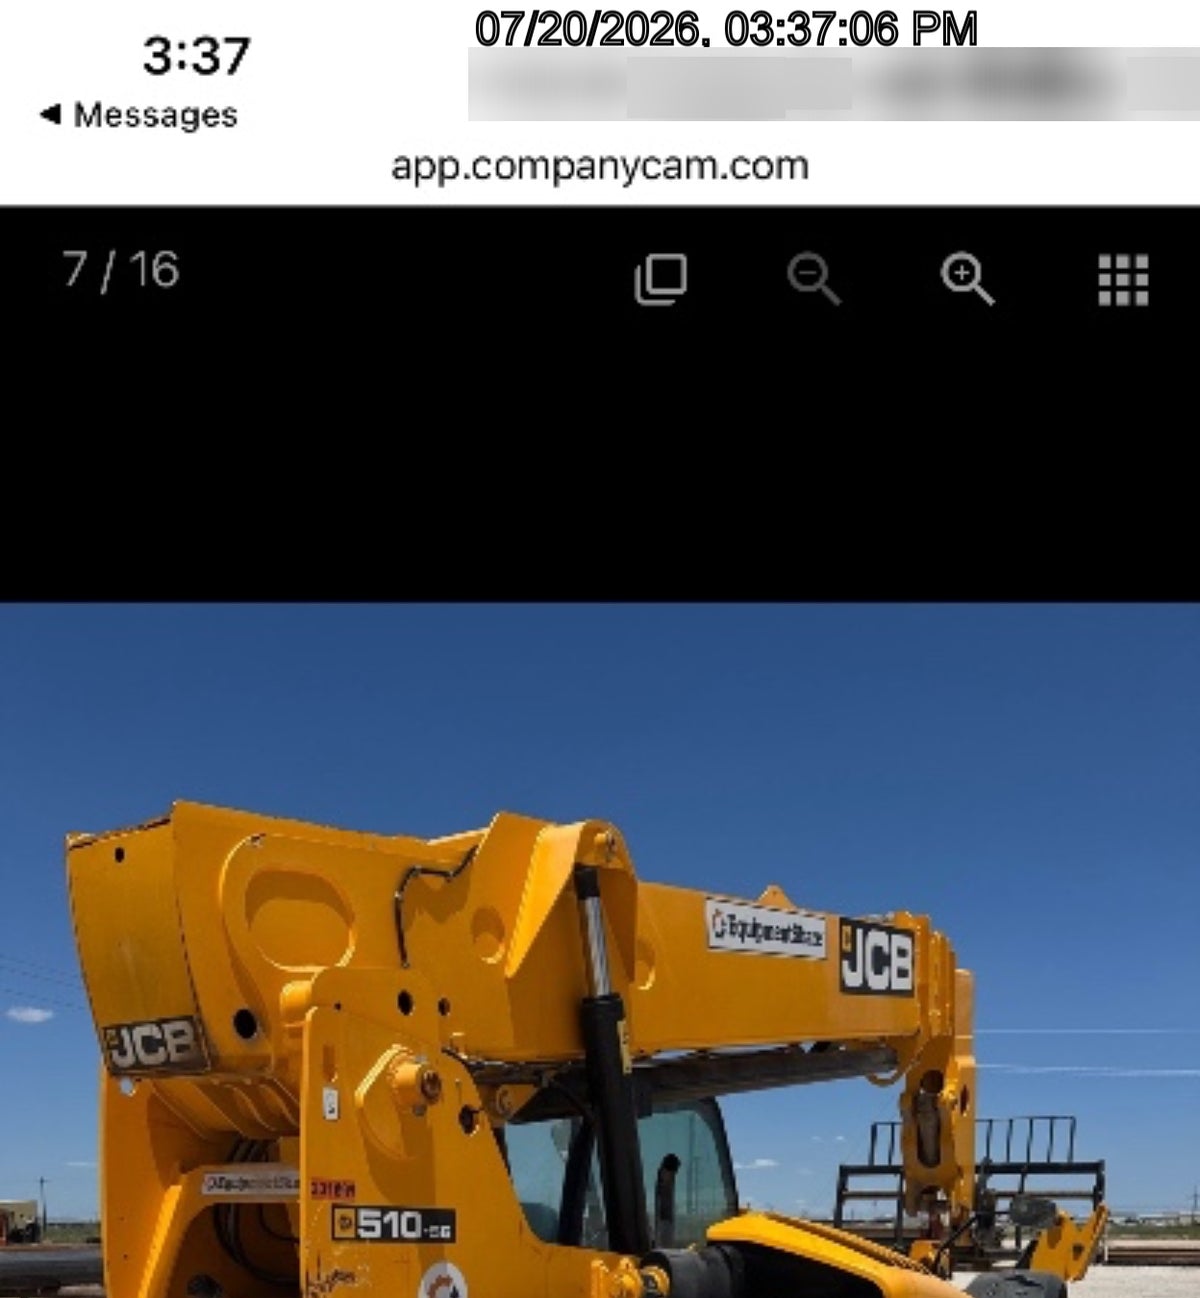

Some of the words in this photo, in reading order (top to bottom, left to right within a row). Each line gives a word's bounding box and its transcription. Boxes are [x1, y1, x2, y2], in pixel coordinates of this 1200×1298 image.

[144, 37, 250, 75] 3:37
[76, 102, 238, 134] Messages
[392, 155, 809, 188] app.companycam.com
[63, 250, 88, 287] 7
[130, 250, 180, 288] 16
[841, 927, 913, 991] JCB
[111, 1020, 195, 1068] JCB
